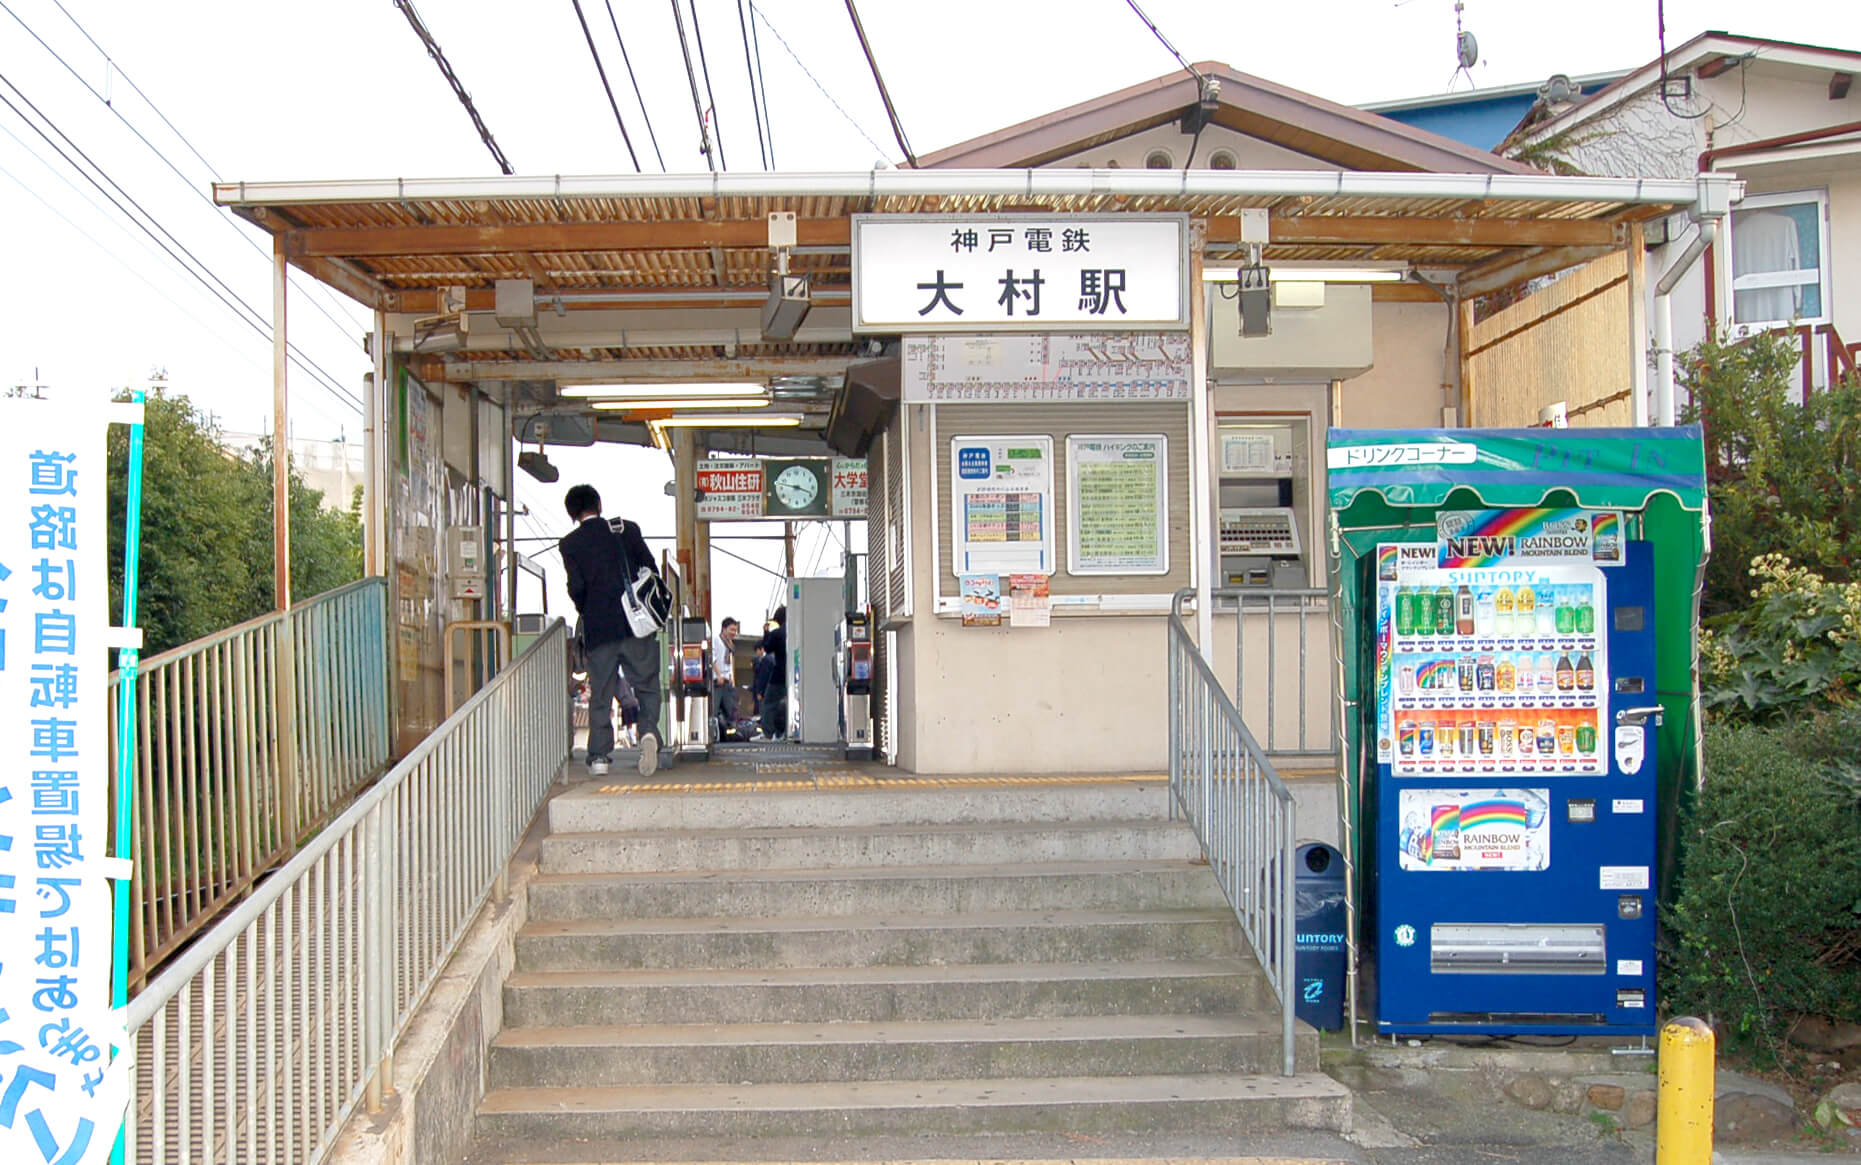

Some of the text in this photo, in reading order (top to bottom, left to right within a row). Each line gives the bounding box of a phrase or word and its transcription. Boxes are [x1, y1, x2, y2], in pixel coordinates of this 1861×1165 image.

[950, 228, 1091, 253] 神戸電鉄
[917, 269, 1128, 316] 大村駅
[1348, 446, 1465, 465] ドリンクコーナー
[1446, 535, 1516, 559] NEW!
[1520, 536, 1589, 548] RAINBOW
[1520, 549, 1562, 557] MOUNTAIN
[1463, 834, 1521, 844] RAINBOW
[1296, 934, 1345, 943] UNTORY
